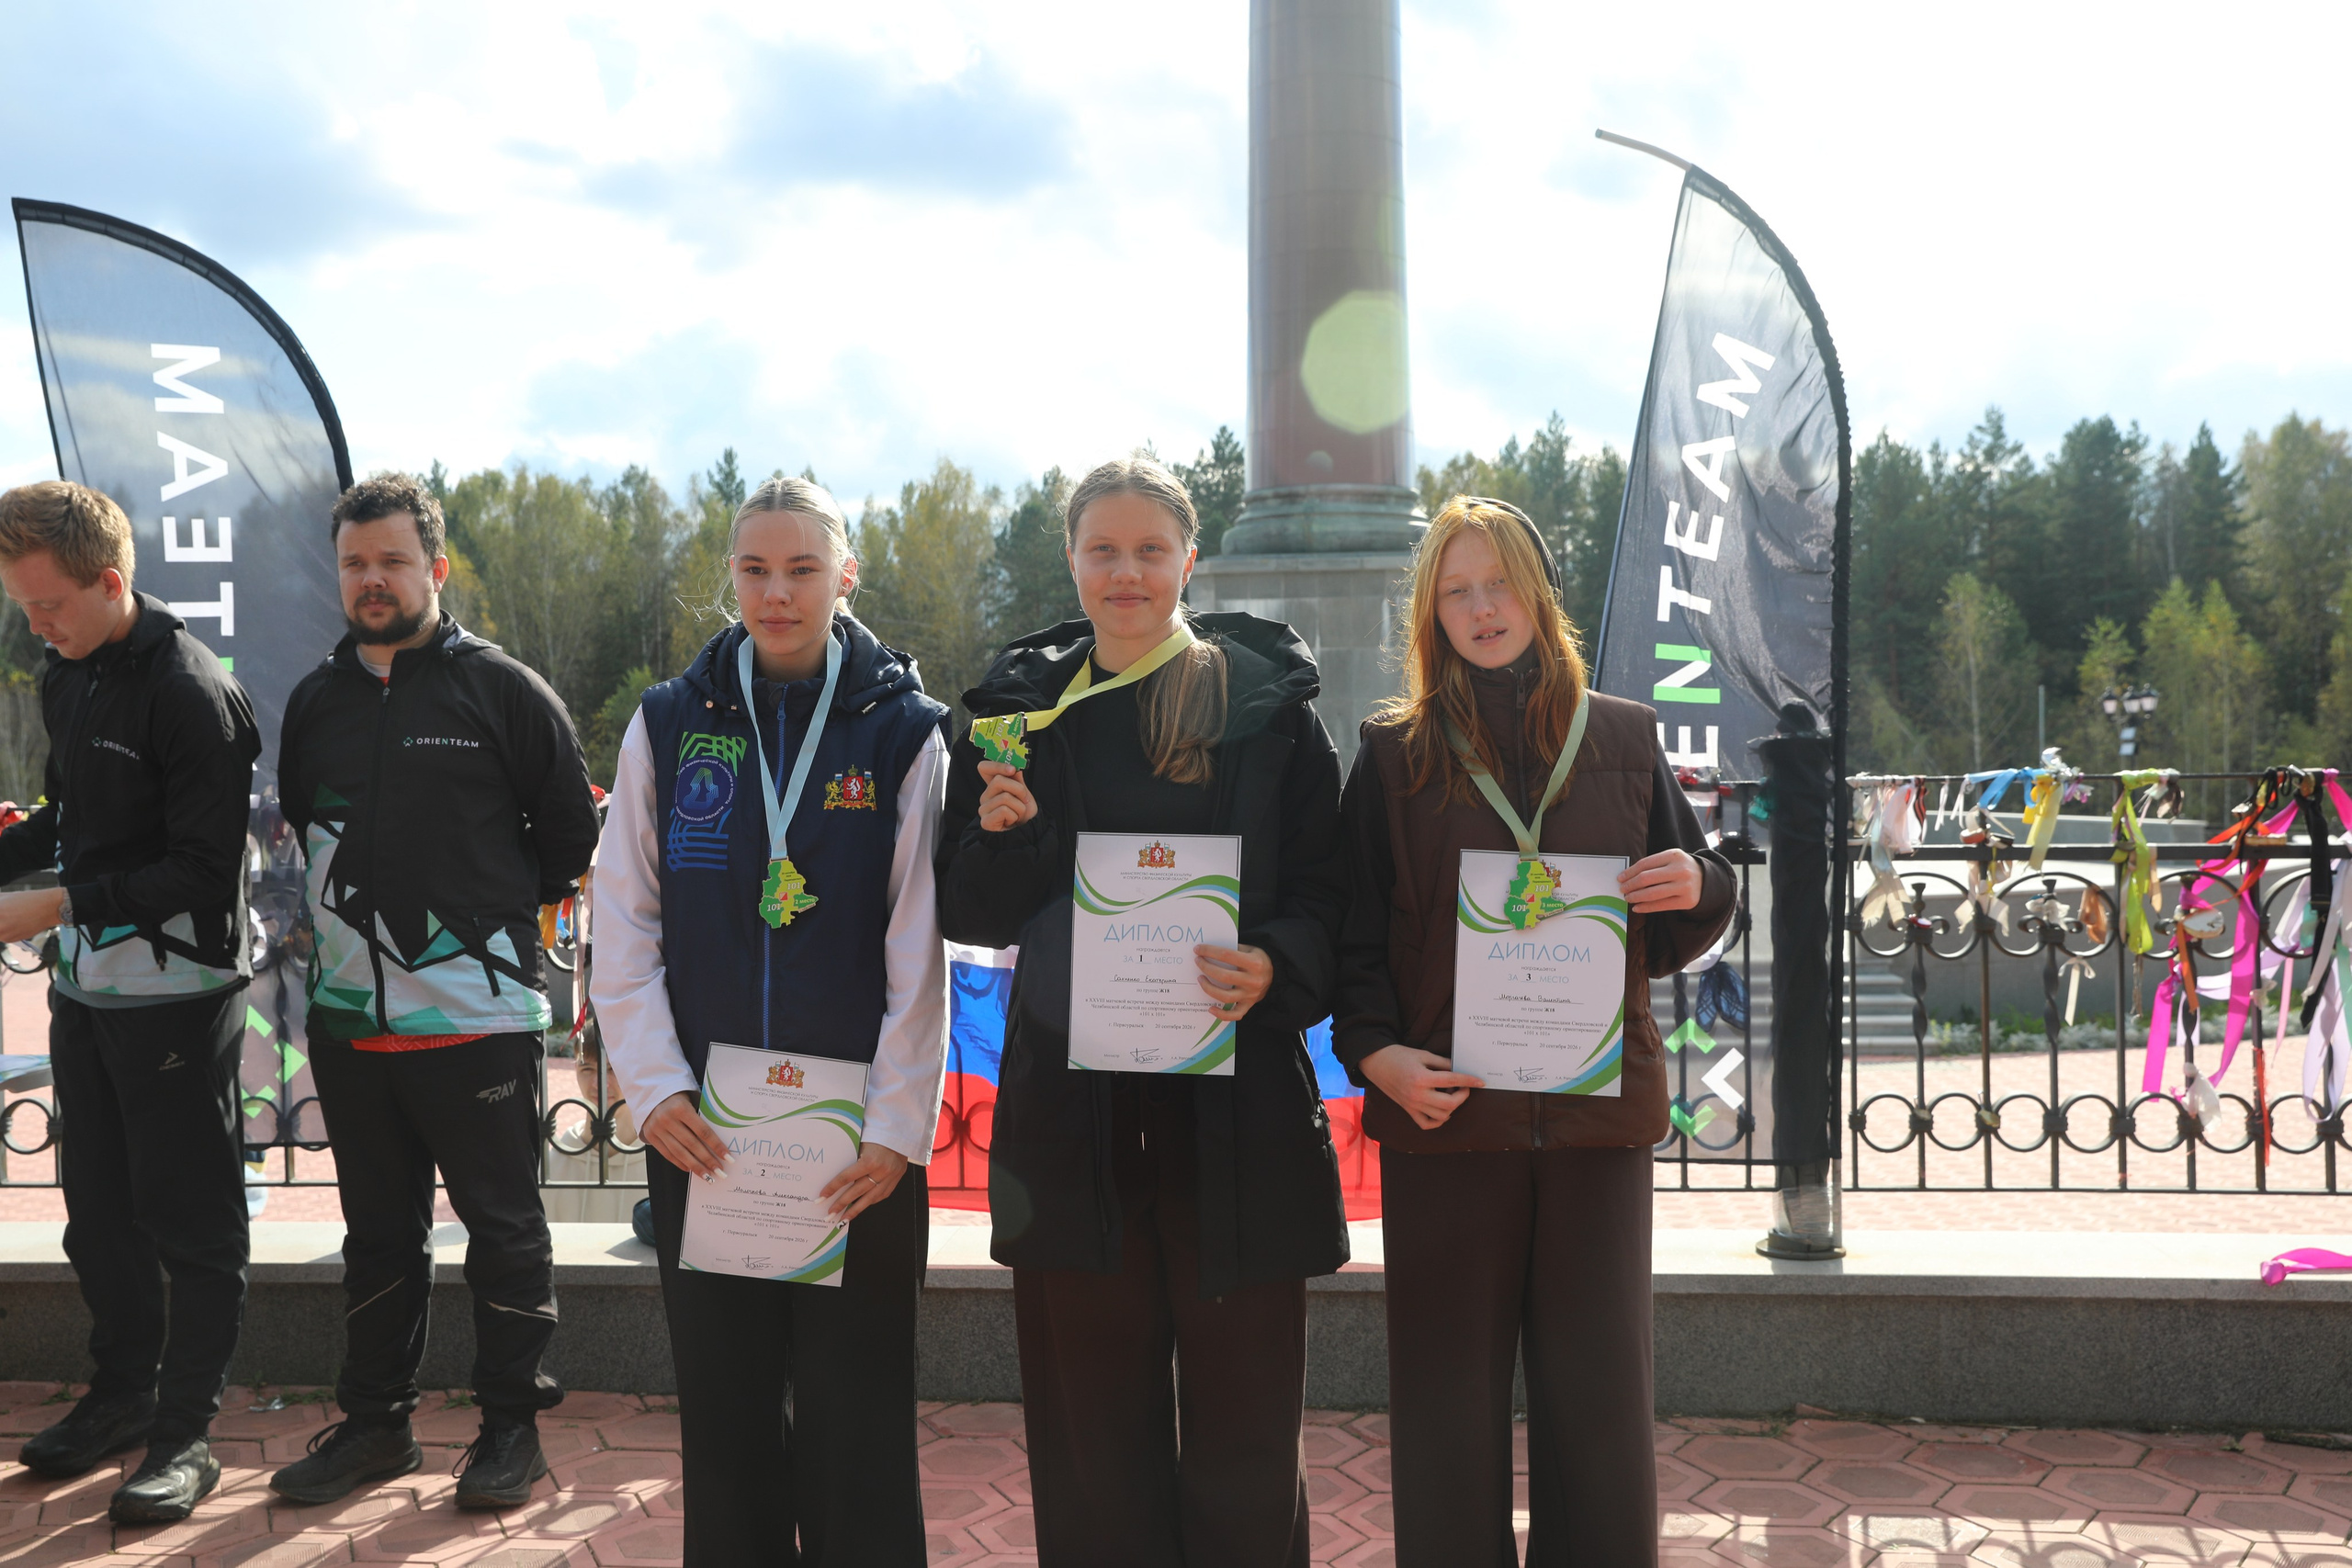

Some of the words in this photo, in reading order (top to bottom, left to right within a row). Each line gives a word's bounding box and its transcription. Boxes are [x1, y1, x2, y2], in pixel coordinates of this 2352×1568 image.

[996, 723, 1004, 737] 101
[416, 738, 479, 748] ORIENTEAM
[787, 882, 801, 890] 101
[766, 903, 781, 912] 101
[1511, 904, 1527, 912] 101
[1103, 922, 1204, 944] ДИПЛОМ
[1487, 940, 1590, 965] ДИПЛОМ
[1123, 954, 1134, 963] ЗА
[1154, 955, 1182, 964] МЕСТО
[1508, 973, 1519, 981] ЗА
[1525, 973, 1531, 981] 3
[1539, 975, 1569, 984] МЕСТО
[477, 1078, 516, 1103] RAY
[727, 1135, 825, 1164] ДИПЛОМ
[755, 1161, 790, 1170] награждается
[741, 1168, 753, 1176] ЗА
[760, 1168, 765, 1177] 2
[773, 1171, 801, 1181] МЕСТО
